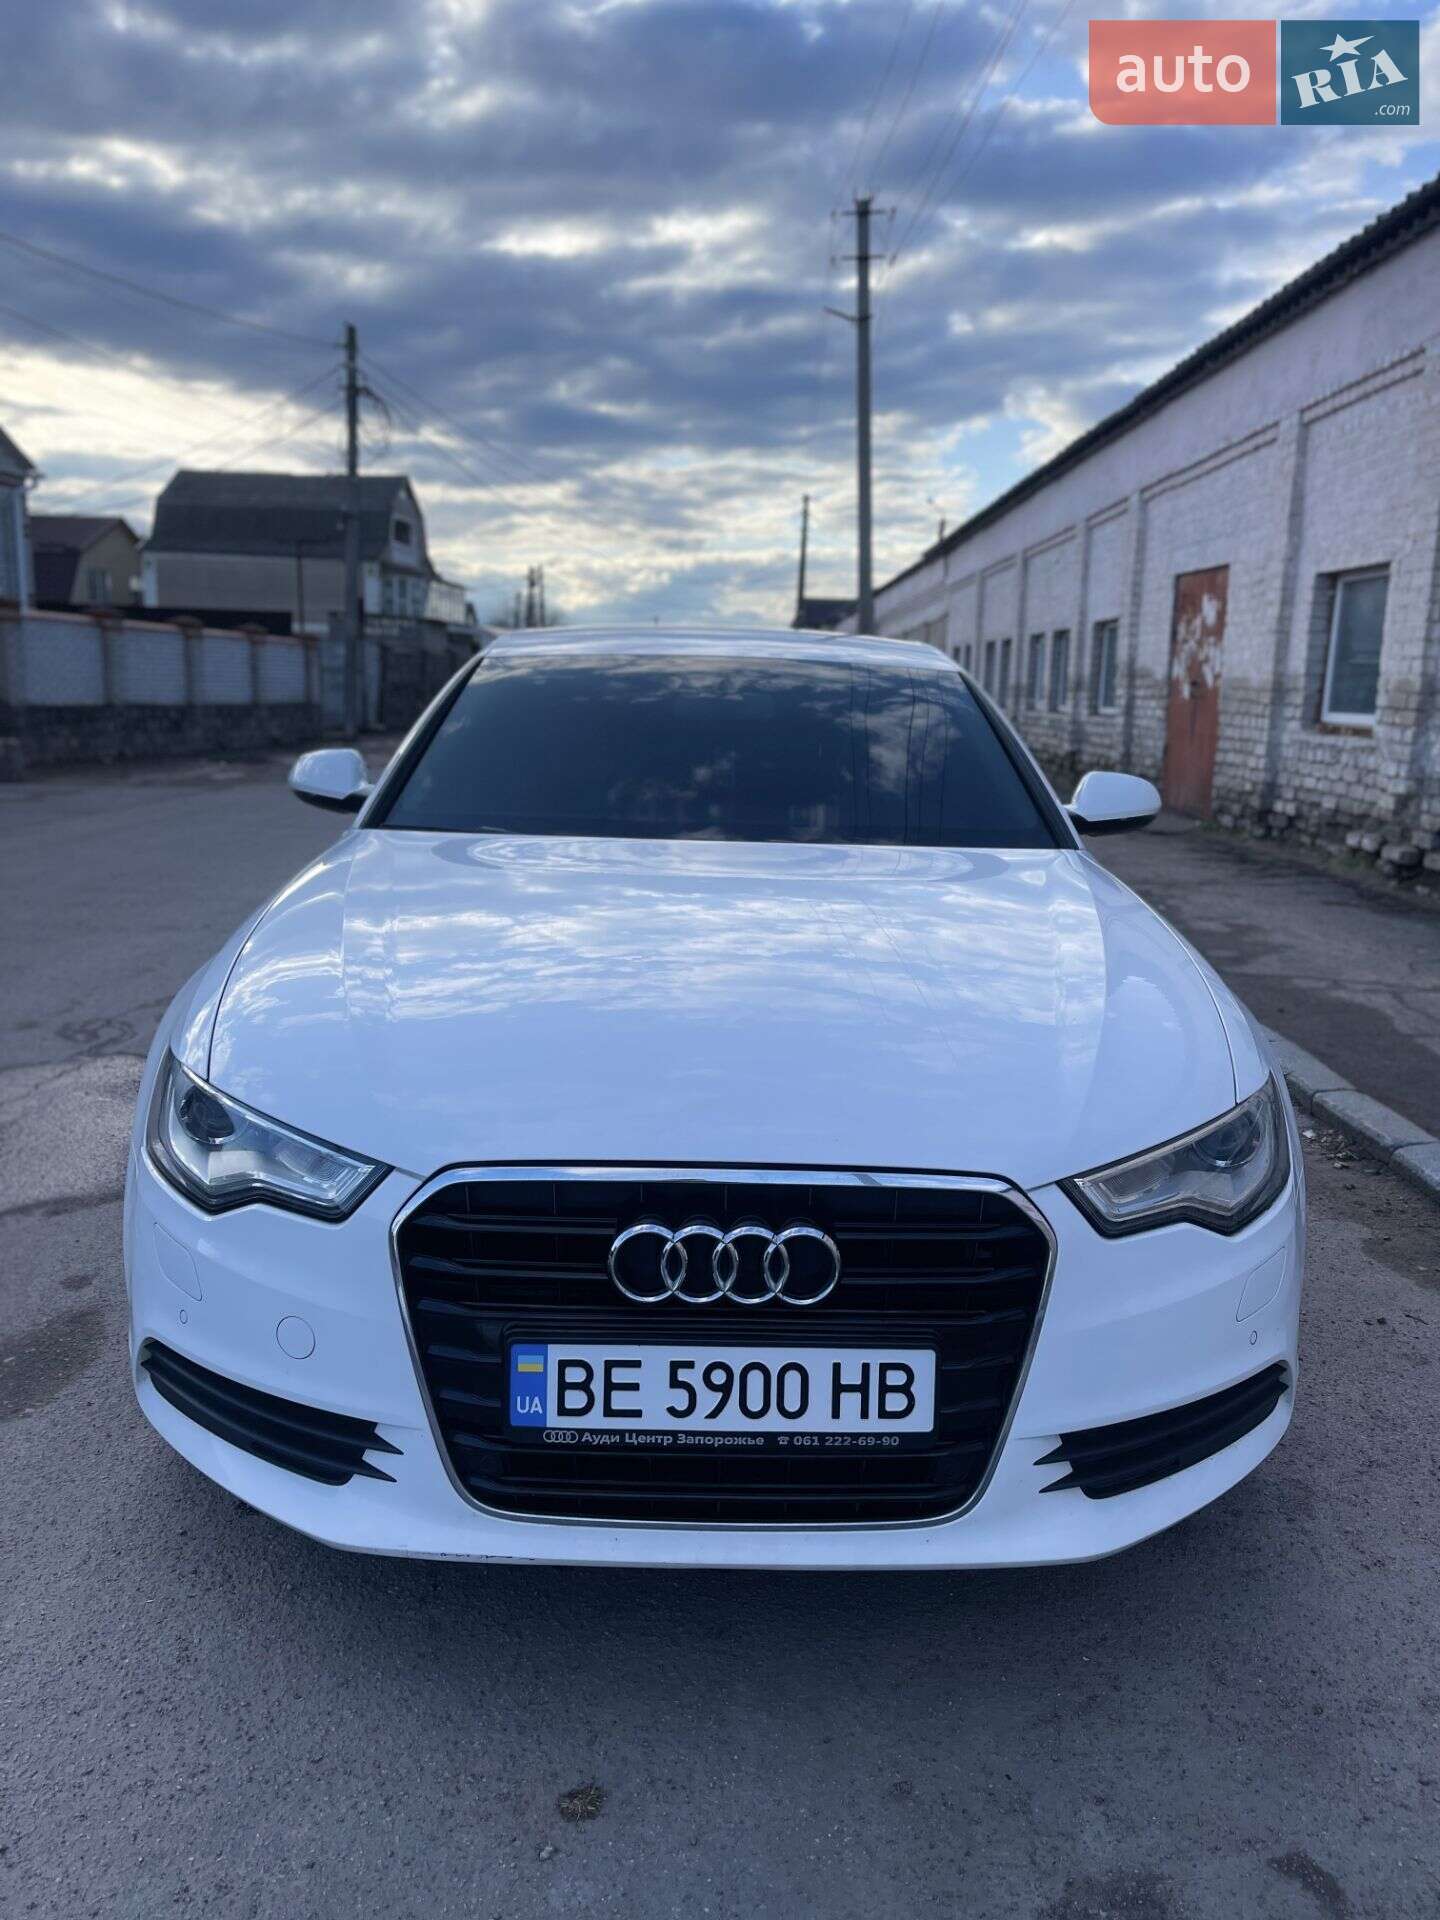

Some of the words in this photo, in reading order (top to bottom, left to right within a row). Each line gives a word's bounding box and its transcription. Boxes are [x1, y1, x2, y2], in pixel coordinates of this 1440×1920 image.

[556, 1359, 642, 1418] BE
[665, 1361, 810, 1419] 5900
[831, 1362, 916, 1420] HB
[516, 1397, 543, 1414] UA
[581, 1432, 620, 1446] Ауди
[624, 1432, 673, 1447] Центр
[677, 1434, 764, 1447] Запорожье
[793, 1435, 820, 1446] 061
[824, 1435, 900, 1447] 222-69-90
